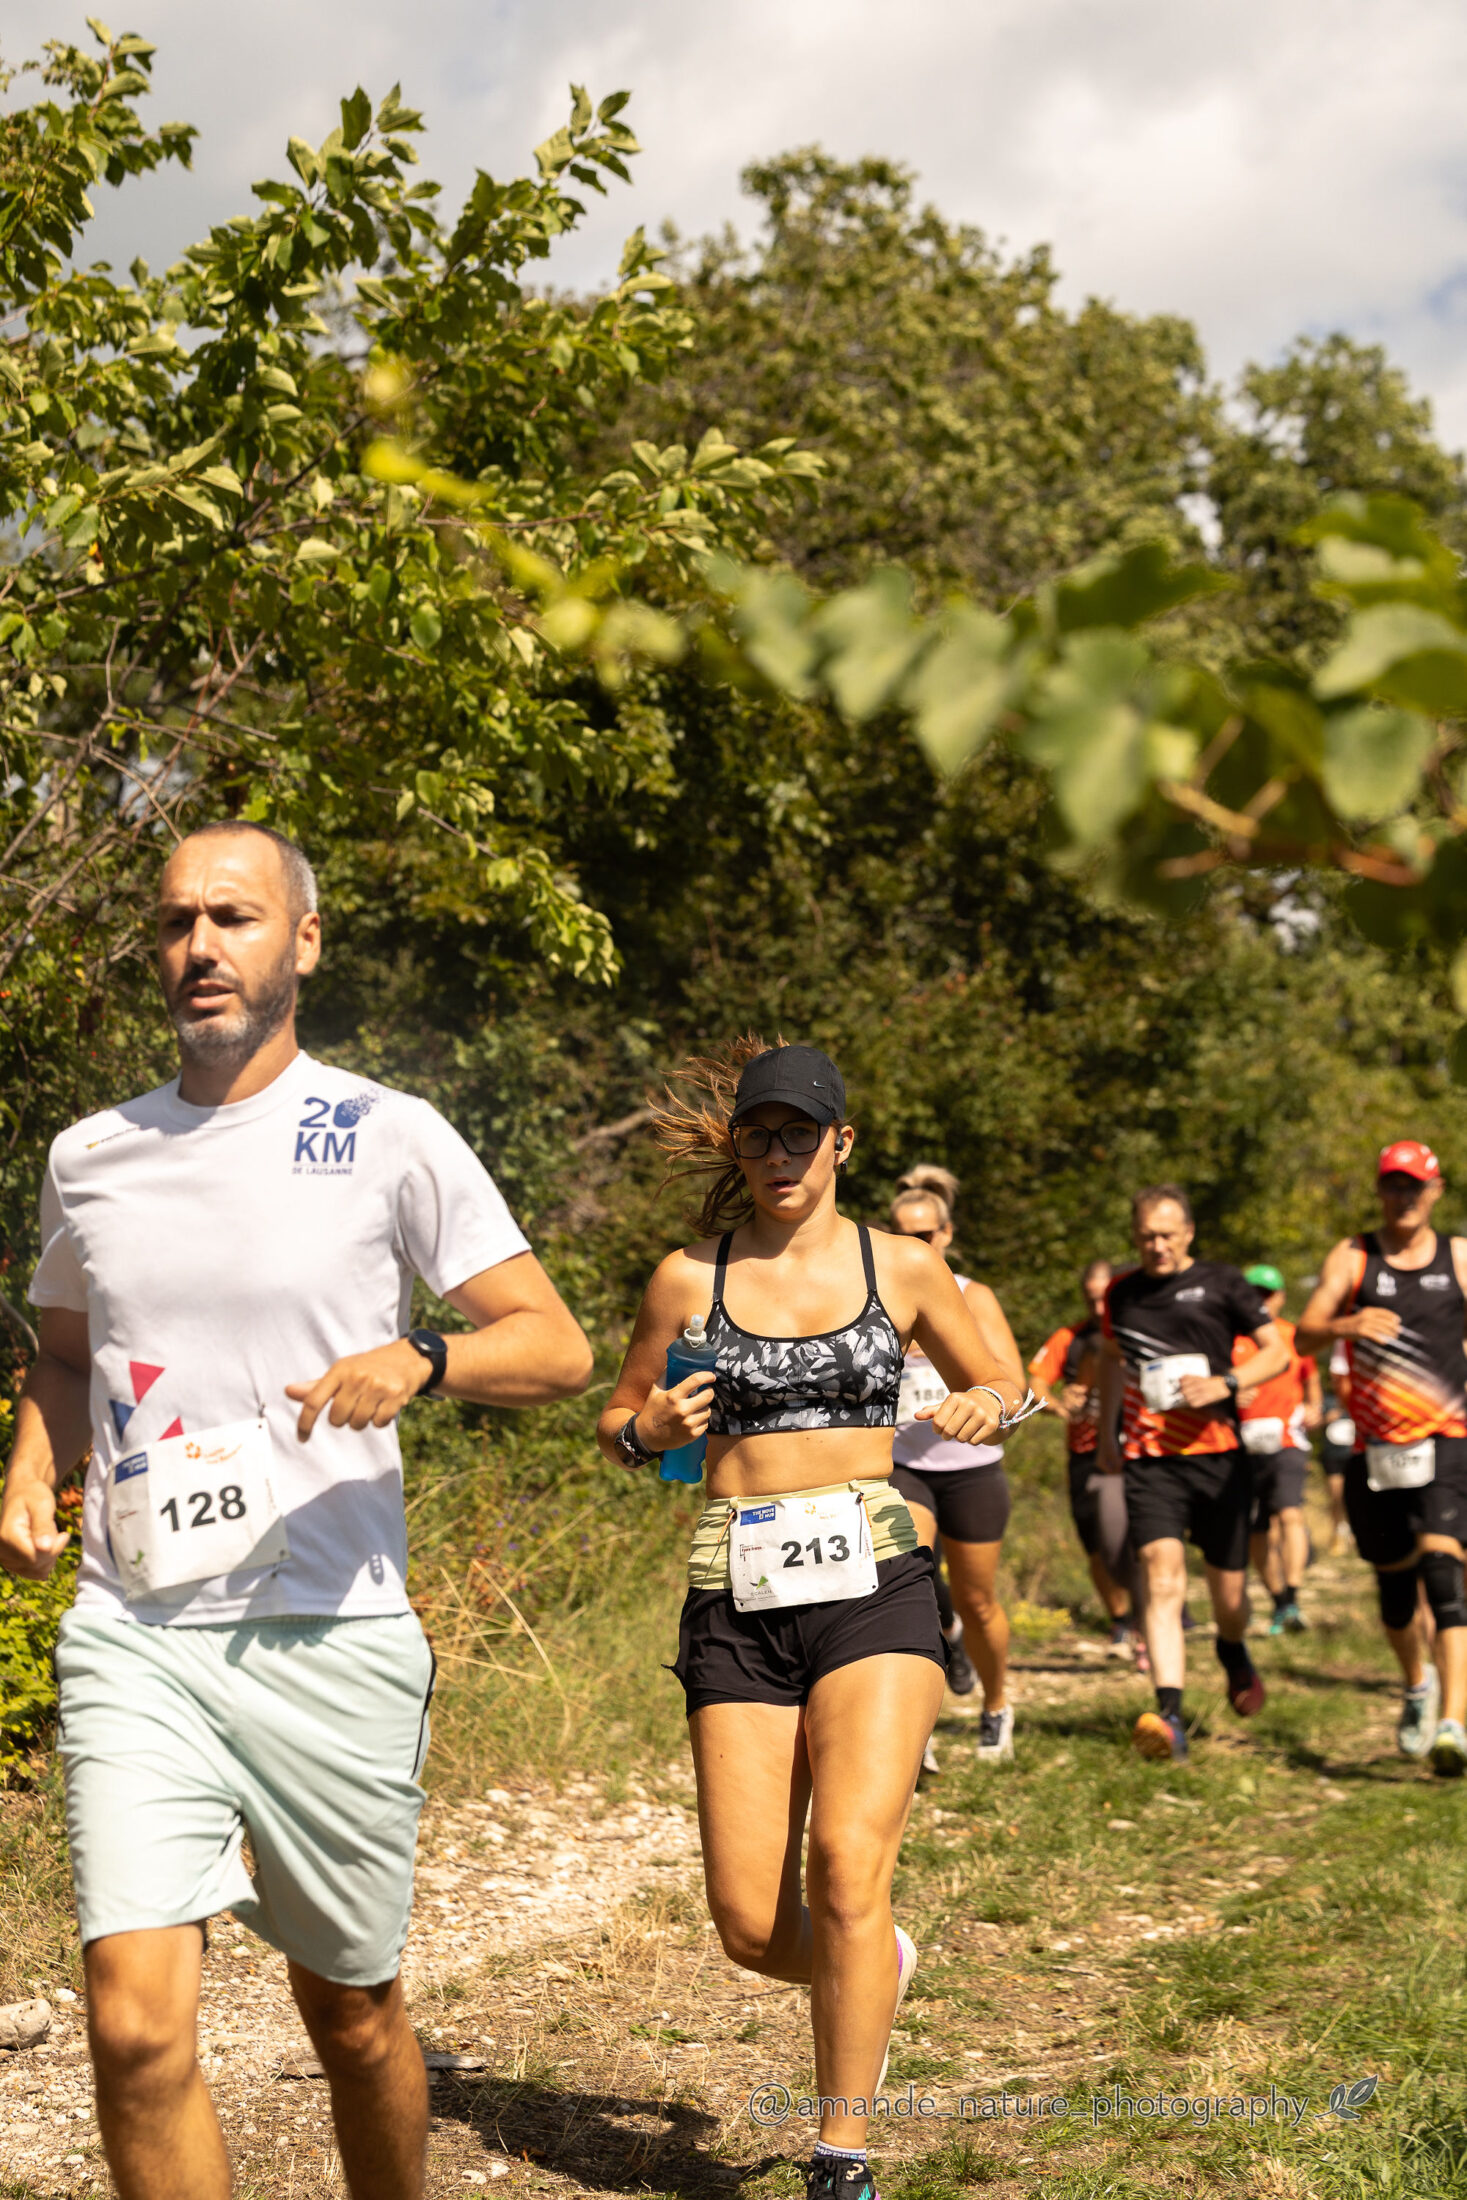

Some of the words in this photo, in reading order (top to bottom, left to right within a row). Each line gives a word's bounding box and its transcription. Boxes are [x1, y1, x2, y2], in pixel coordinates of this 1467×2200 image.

[294, 1131, 356, 1163] KM
[306, 1167, 353, 1175] LAUSANNE
[160, 1485, 247, 1533] 128
[780, 1534, 851, 1569] 213
